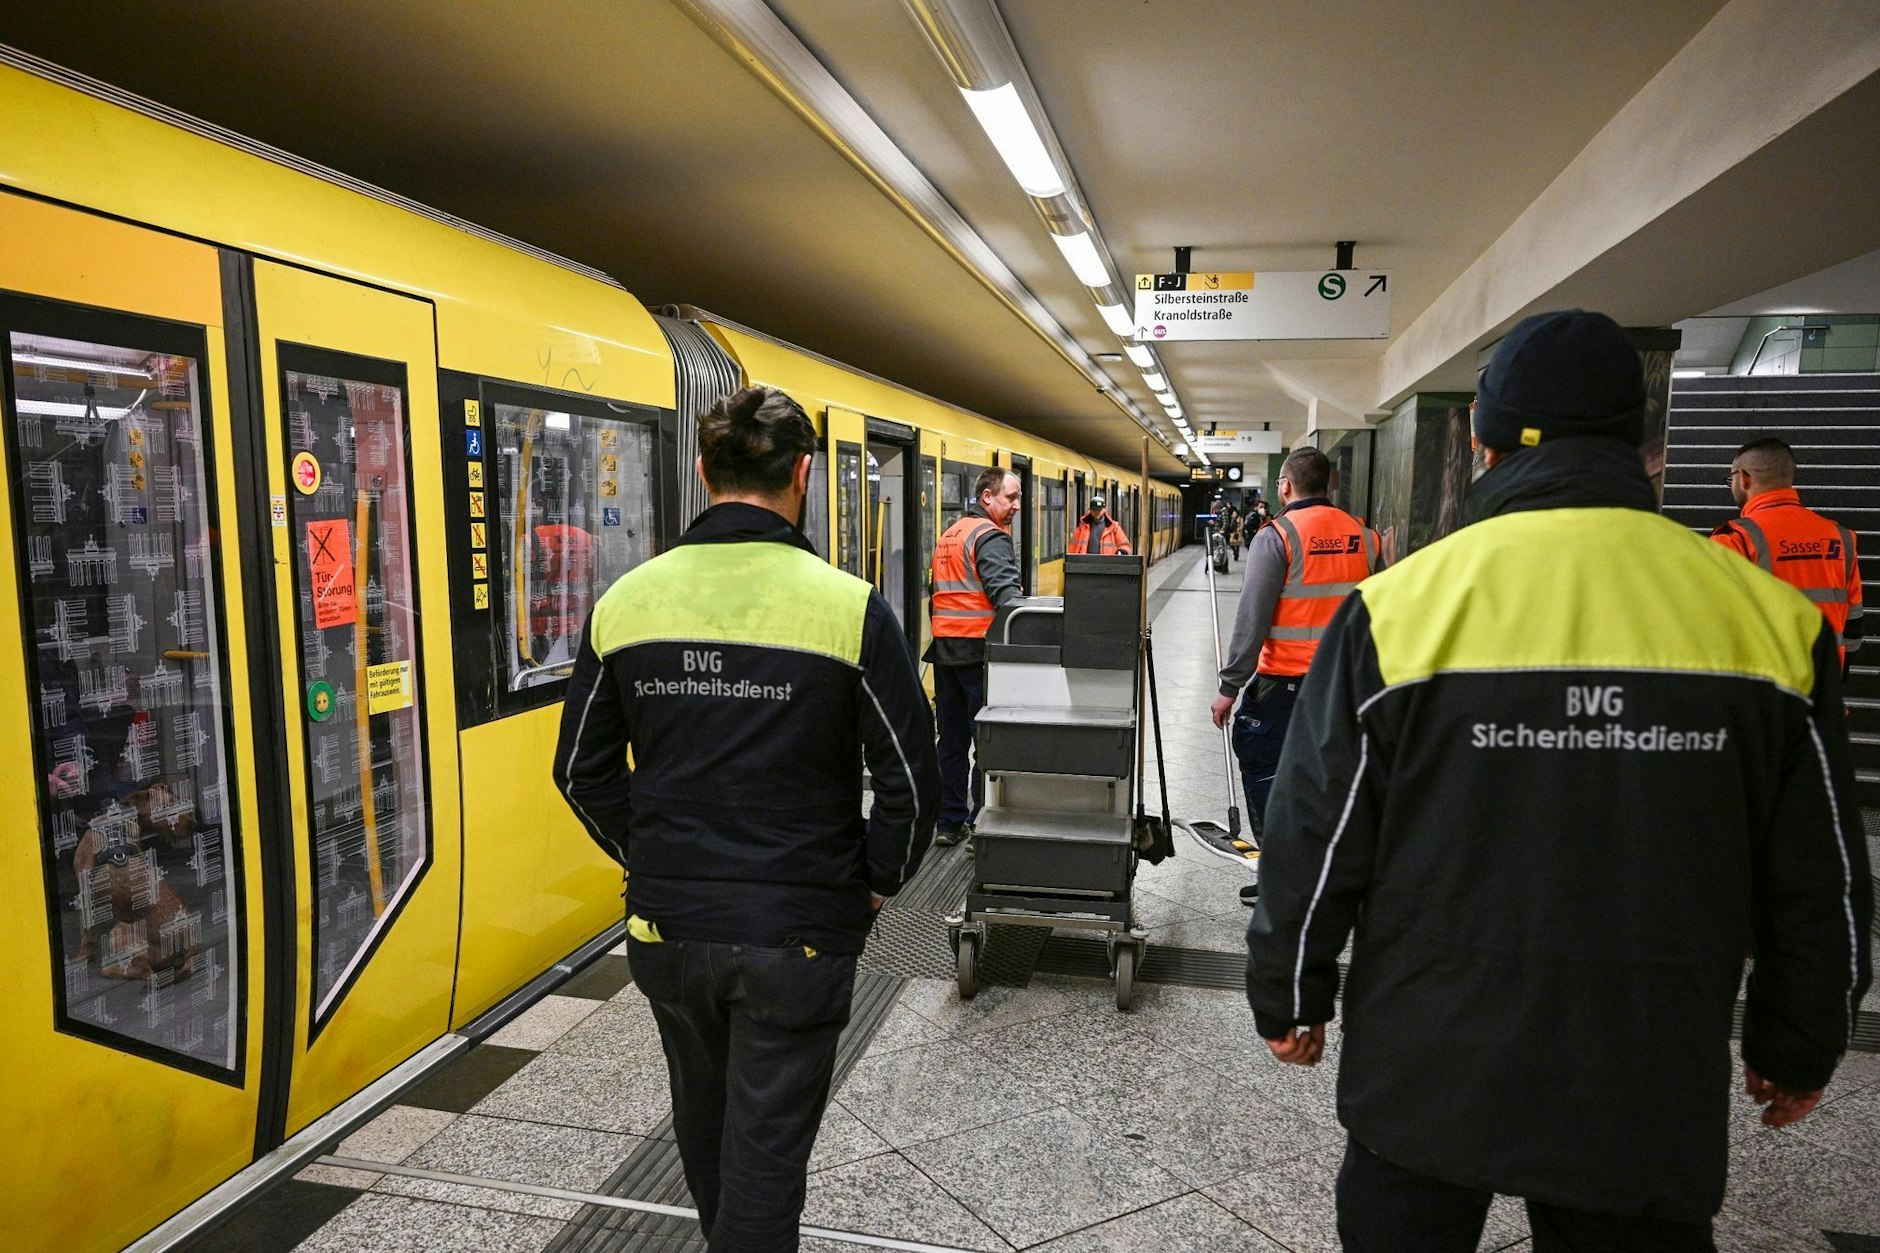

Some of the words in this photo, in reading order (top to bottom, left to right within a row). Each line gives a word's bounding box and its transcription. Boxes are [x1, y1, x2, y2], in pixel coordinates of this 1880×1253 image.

[1158, 276, 1166, 288] F
[1175, 276, 1181, 288] J
[1154, 291, 1249, 304] Silbersteinstraße
[1154, 309, 1233, 321] Kranoldstraße
[1310, 536, 1342, 549] Sasse
[1780, 540, 1822, 554] Sasse
[315, 571, 334, 584] Tür-
[317, 584, 352, 599] Störung
[683, 650, 723, 673] BVG
[369, 667, 399, 678] Beförderung
[370, 680, 378, 688] mit
[370, 687, 400, 699] Fahrausweis
[1566, 686, 1624, 717] BVG
[1471, 723, 1728, 751] Sicherheitsdienst
